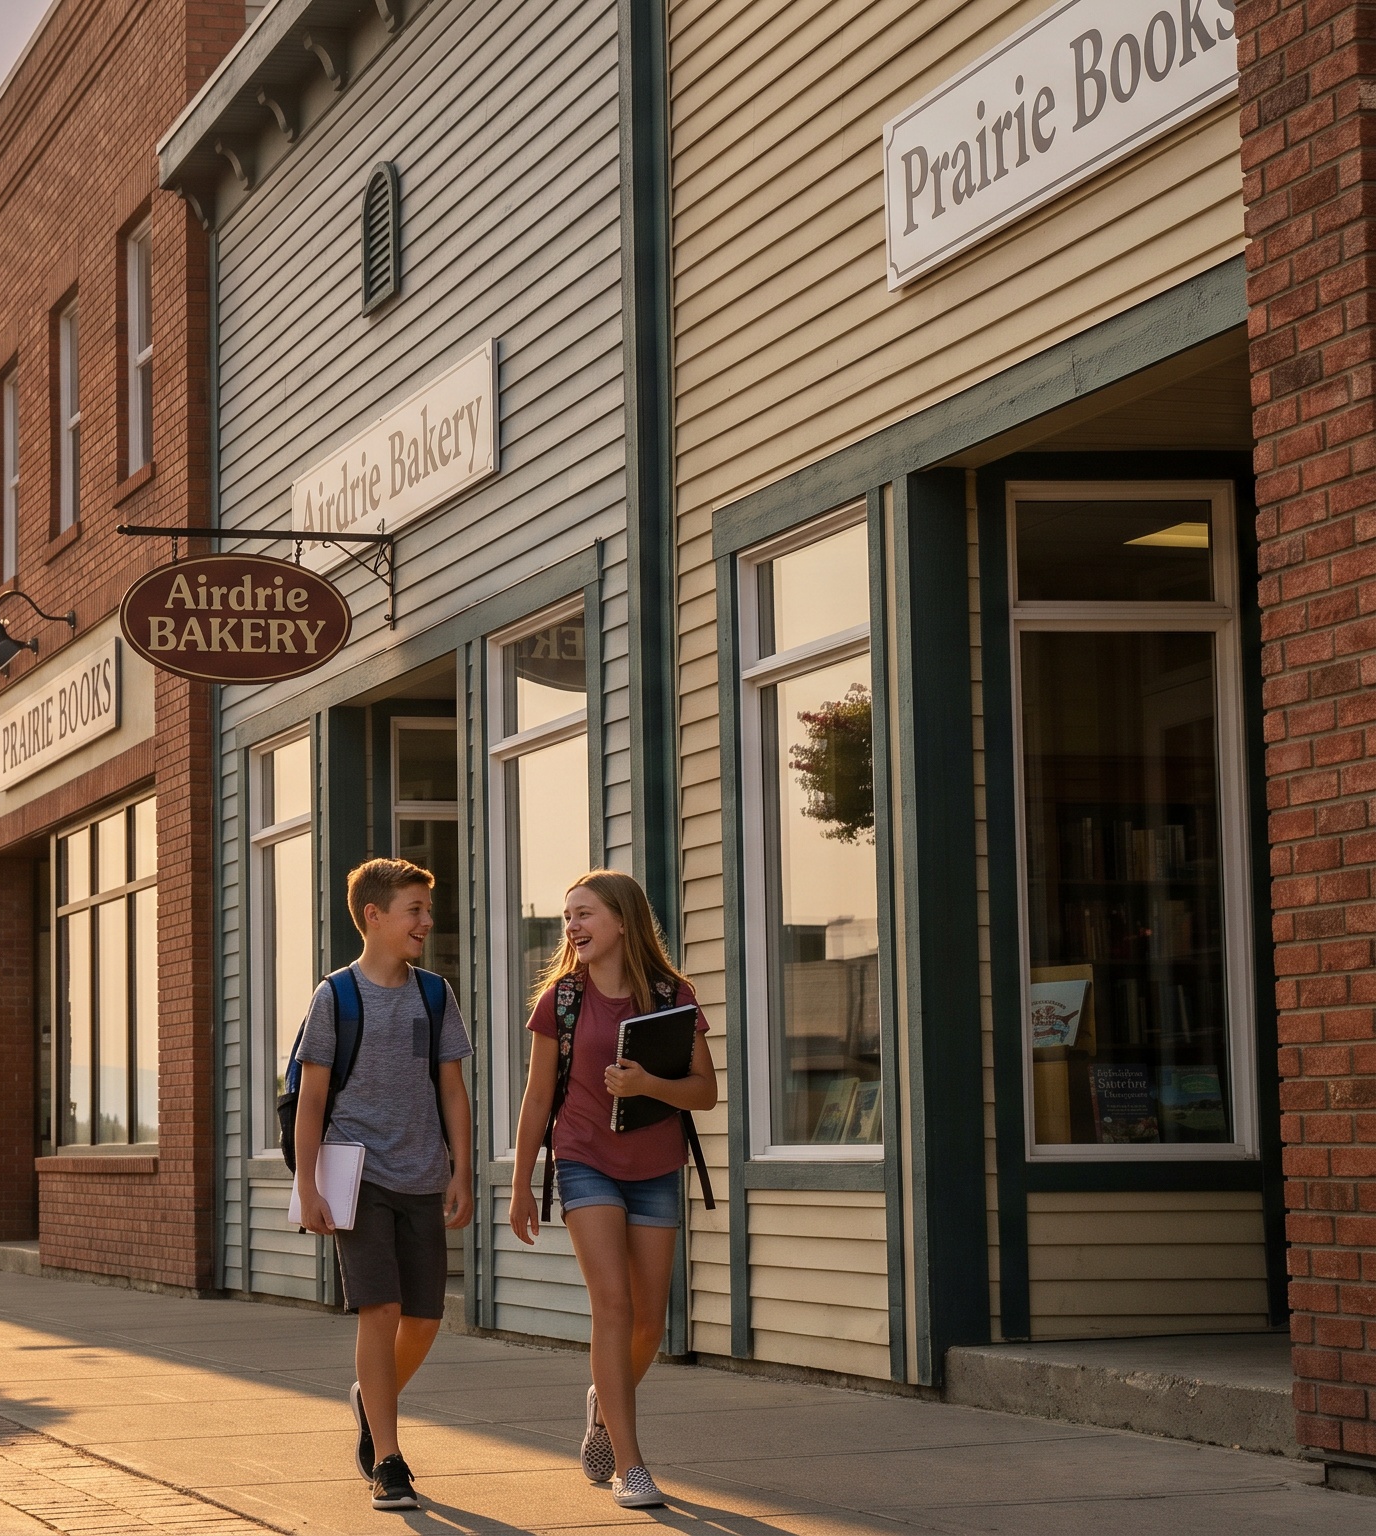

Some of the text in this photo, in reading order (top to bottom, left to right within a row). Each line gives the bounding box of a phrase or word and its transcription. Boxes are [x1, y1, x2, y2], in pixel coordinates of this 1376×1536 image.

[901, 75, 1057, 236] Prairie
[303, 395, 483, 551] Airdrie Bakery
[147, 616, 326, 654] BAKERY
[164, 573, 309, 612] Airdrie
[2, 657, 112, 774] PRAIRIE BOOKS
